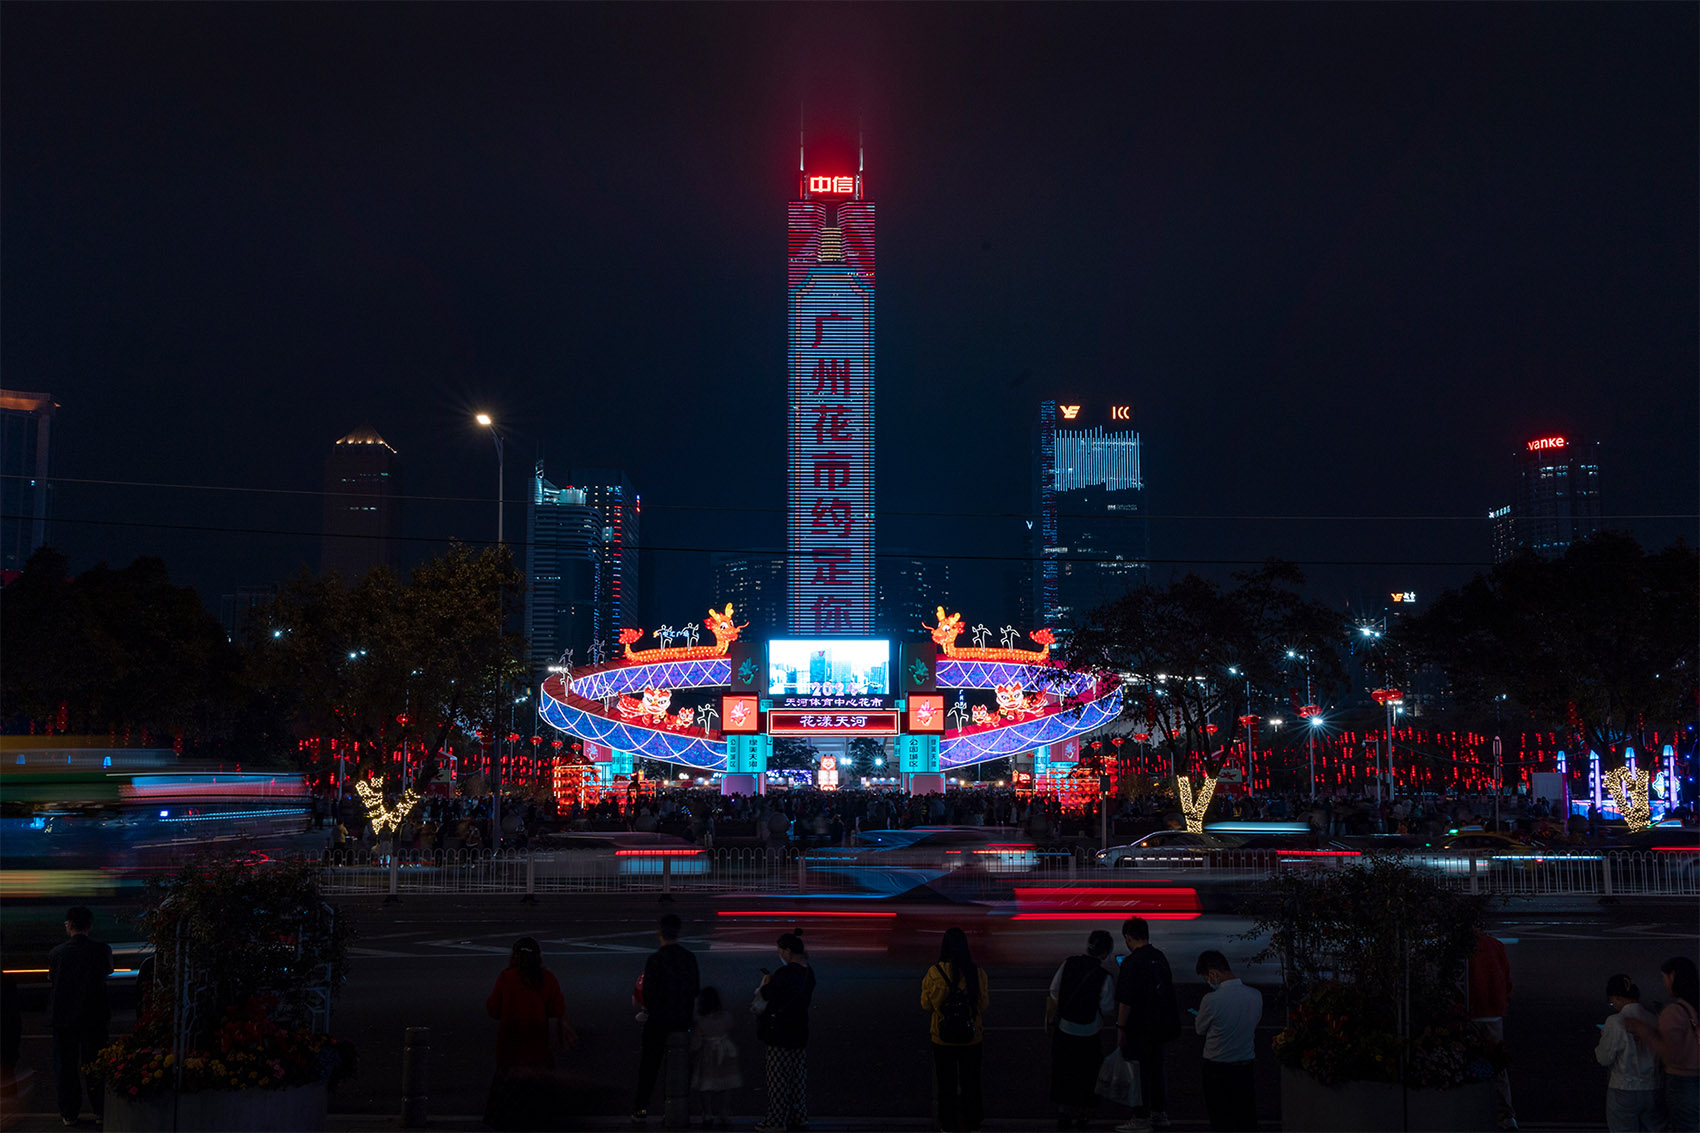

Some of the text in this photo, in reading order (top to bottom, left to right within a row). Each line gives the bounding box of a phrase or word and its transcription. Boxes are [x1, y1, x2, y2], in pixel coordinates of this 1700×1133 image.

[810, 176, 853, 193] 中信
[1112, 406, 1130, 420] ICC
[1528, 437, 1565, 451] vanke
[812, 311, 854, 632] 广州花市约定你
[811, 681, 857, 697] 2024
[784, 698, 883, 707] 天河体育中心花市
[800, 715, 868, 728] 花漾天河
